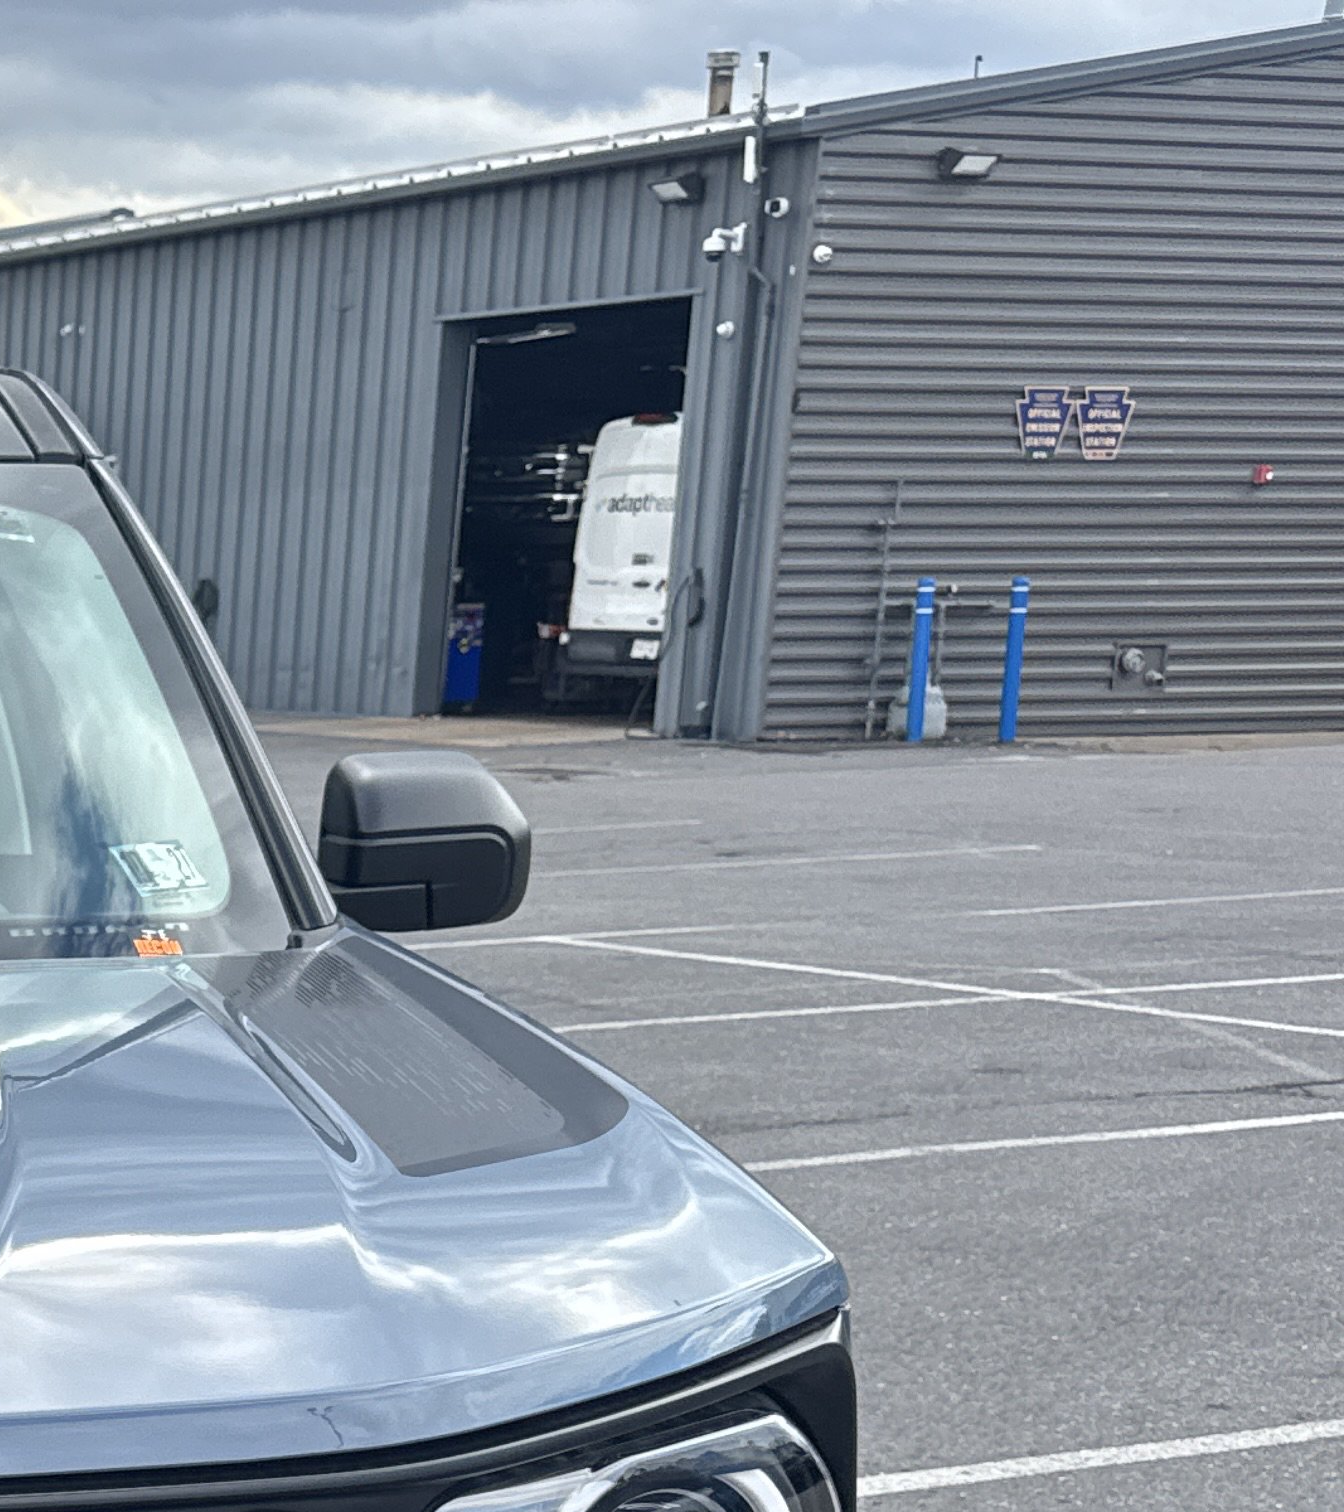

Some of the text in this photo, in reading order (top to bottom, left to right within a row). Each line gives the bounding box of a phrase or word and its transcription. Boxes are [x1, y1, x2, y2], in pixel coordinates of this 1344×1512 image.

[1027, 408, 1061, 419] OFFICIAL
[1087, 408, 1122, 419] OFFICIAL
[1024, 436, 1056, 447] STATION
[1085, 436, 1116, 447] STATION
